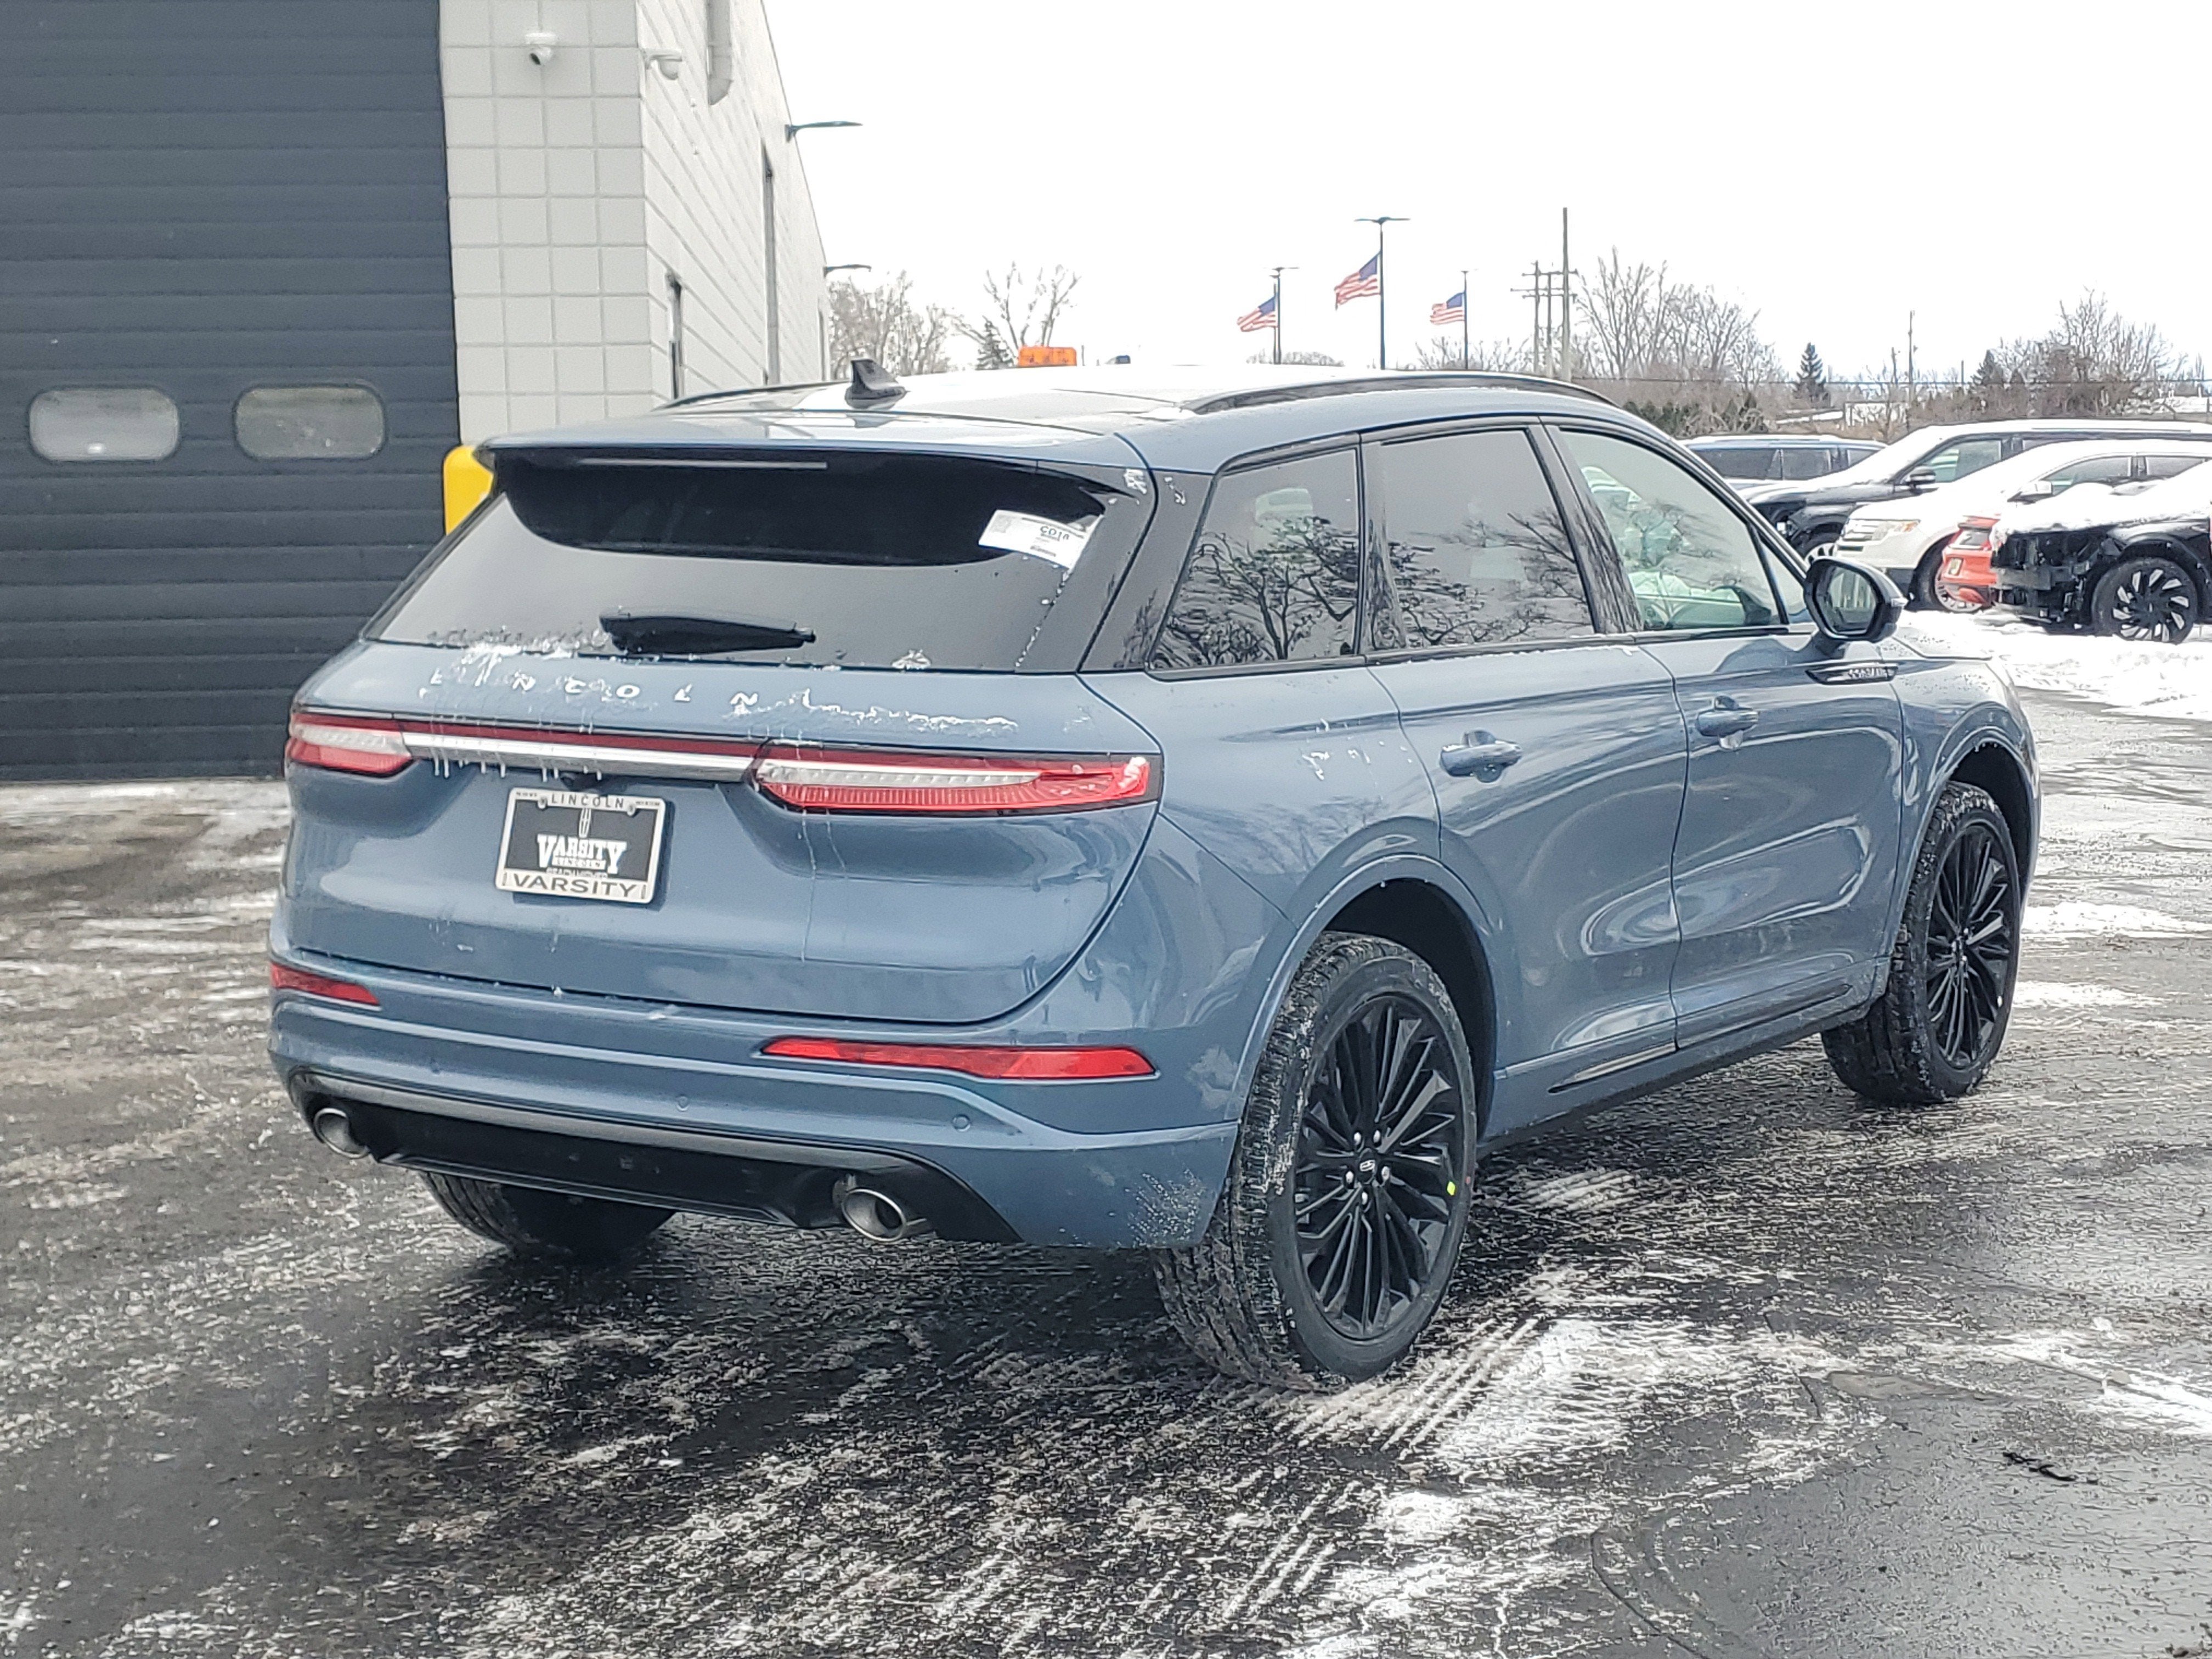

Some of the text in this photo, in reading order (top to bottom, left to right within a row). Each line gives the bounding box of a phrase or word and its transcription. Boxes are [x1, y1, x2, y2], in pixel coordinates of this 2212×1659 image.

[551, 793, 624, 809] LINCOLN
[537, 833, 627, 874] VARSITY
[513, 873, 637, 898] VARSITY
